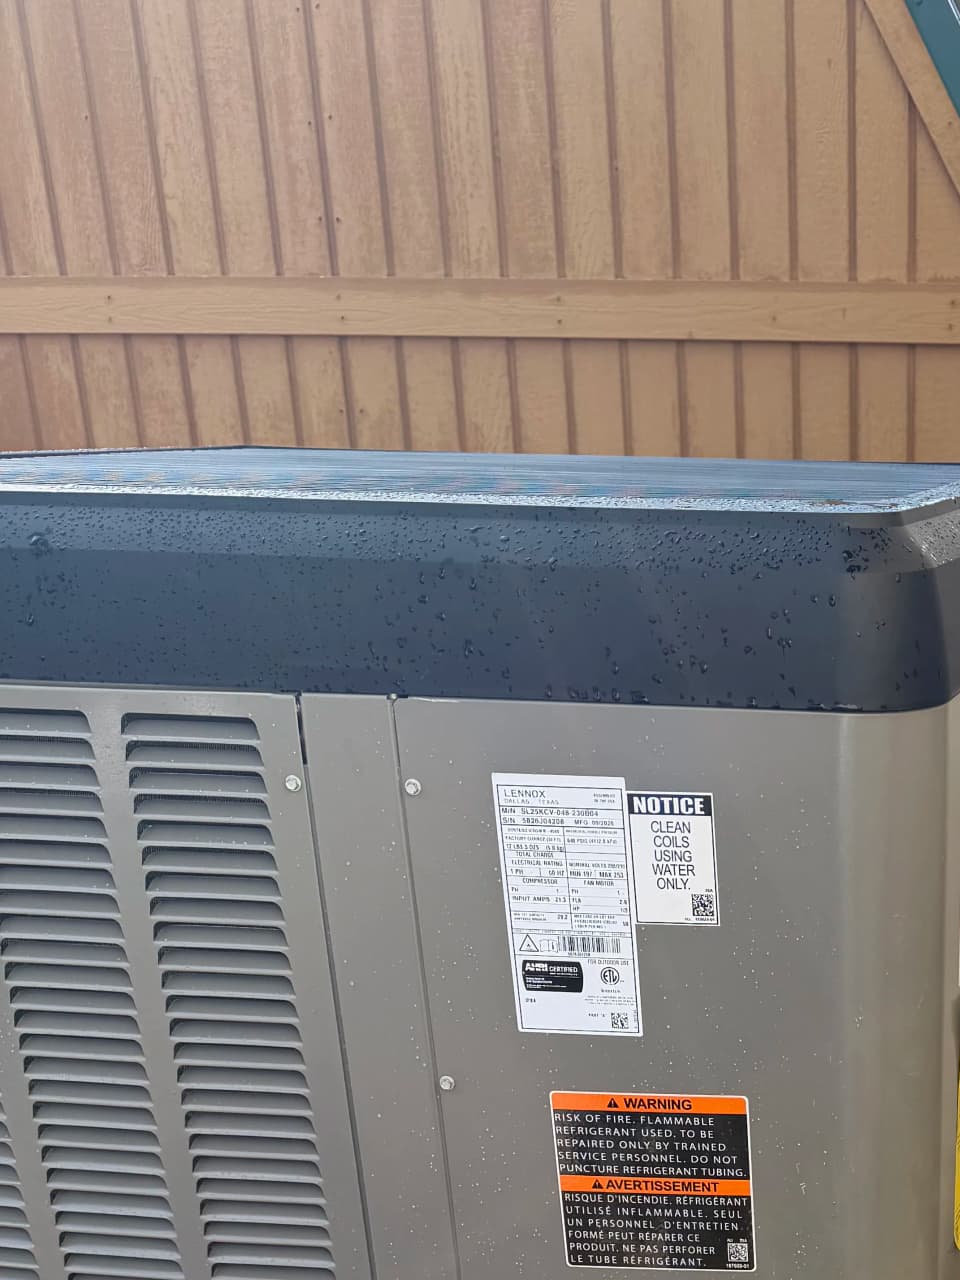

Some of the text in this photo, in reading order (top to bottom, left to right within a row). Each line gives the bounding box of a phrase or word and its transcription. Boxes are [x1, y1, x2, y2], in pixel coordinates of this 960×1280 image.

[503, 789, 546, 798] LENNOX
[632, 796, 705, 815] NOTICE
[650, 820, 691, 834] CLEAN
[653, 835, 690, 848] COILS
[654, 849, 692, 863] USING
[652, 863, 696, 876] WATER
[657, 878, 691, 890] ONLY.
[624, 1098, 692, 1111] WARNING
[554, 1113, 715, 1126] RISK OF FIRE. FLAMMABLE
[555, 1126, 714, 1139] REFRIGERANT USED. TO BE
[557, 1139, 726, 1152] REPAIRED ONLY BY TRAINED
[558, 1152, 737, 1165] SERVICE PERSONNEL. DO NOT
[559, 1164, 747, 1177] PUNCTURE REFRIGERANT TUBING.
[606, 1179, 719, 1193] AVERTISSEMENT
[564, 1193, 747, 1206] RISQUE D'INCENDIE. RÉFRIGÉRANT
[566, 1205, 743, 1219] UTILISÉ INFLAMMABLE. SEUL
[567, 1218, 739, 1231] UN PERSONNEL D'ENTRETIEN
[568, 1229, 700, 1242] FORMÉ PEUT RÉPARER CE
[569, 1242, 715, 1255] PRODUIT. NE PAS PERFORER
[570, 1254, 706, 1267] LE TUBE RÉFRIGÉRANT.
